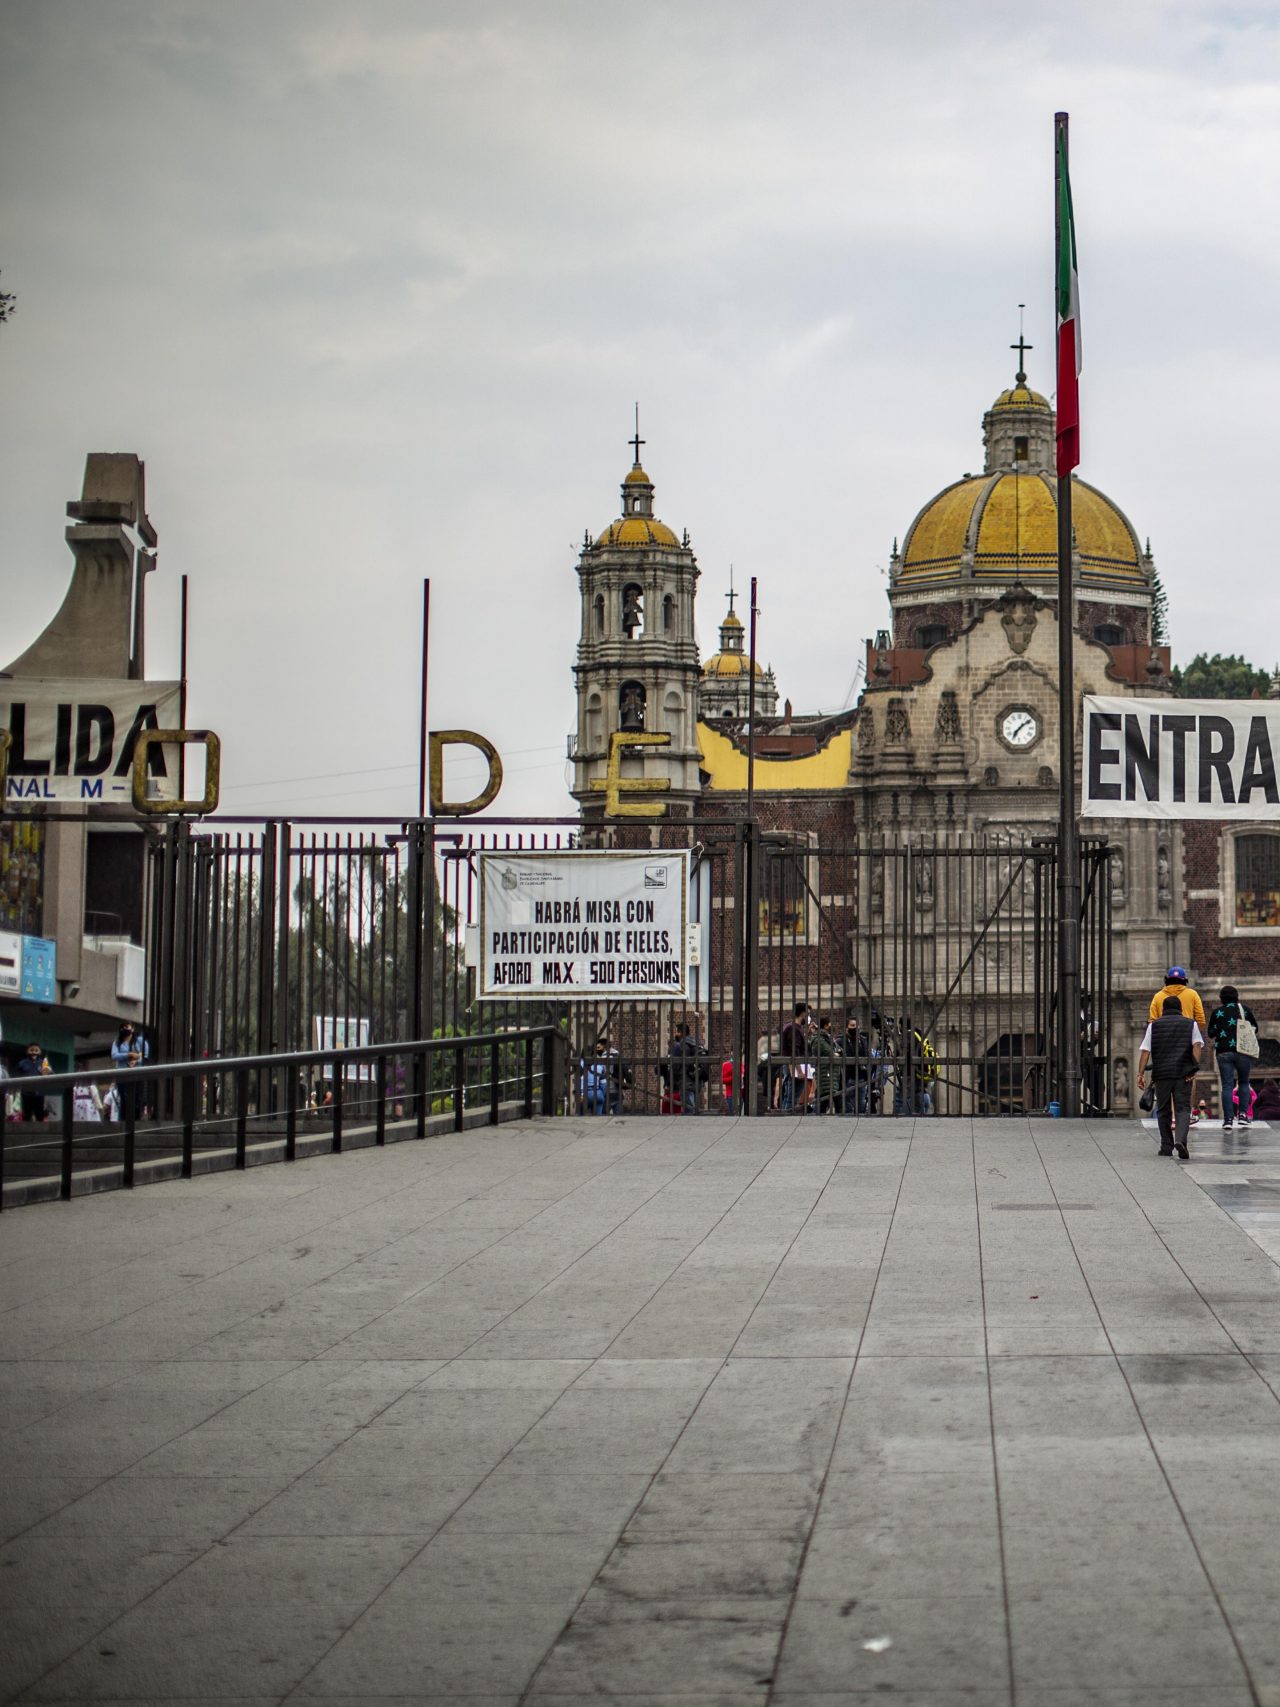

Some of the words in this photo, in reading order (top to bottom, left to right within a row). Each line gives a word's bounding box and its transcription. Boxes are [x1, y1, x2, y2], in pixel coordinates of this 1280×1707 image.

[535, 897, 581, 924] HABRÁ
[586, 900, 621, 923] MISA
[626, 900, 654, 923] CON
[492, 927, 599, 955] PARTICIPACIÓN
[604, 930, 621, 954] DE
[626, 929, 673, 956] FIELES,
[494, 962, 532, 985] AFORO
[542, 961, 579, 984] MAX.
[589, 961, 615, 984] 500
[618, 960, 680, 984] PERSONAS
